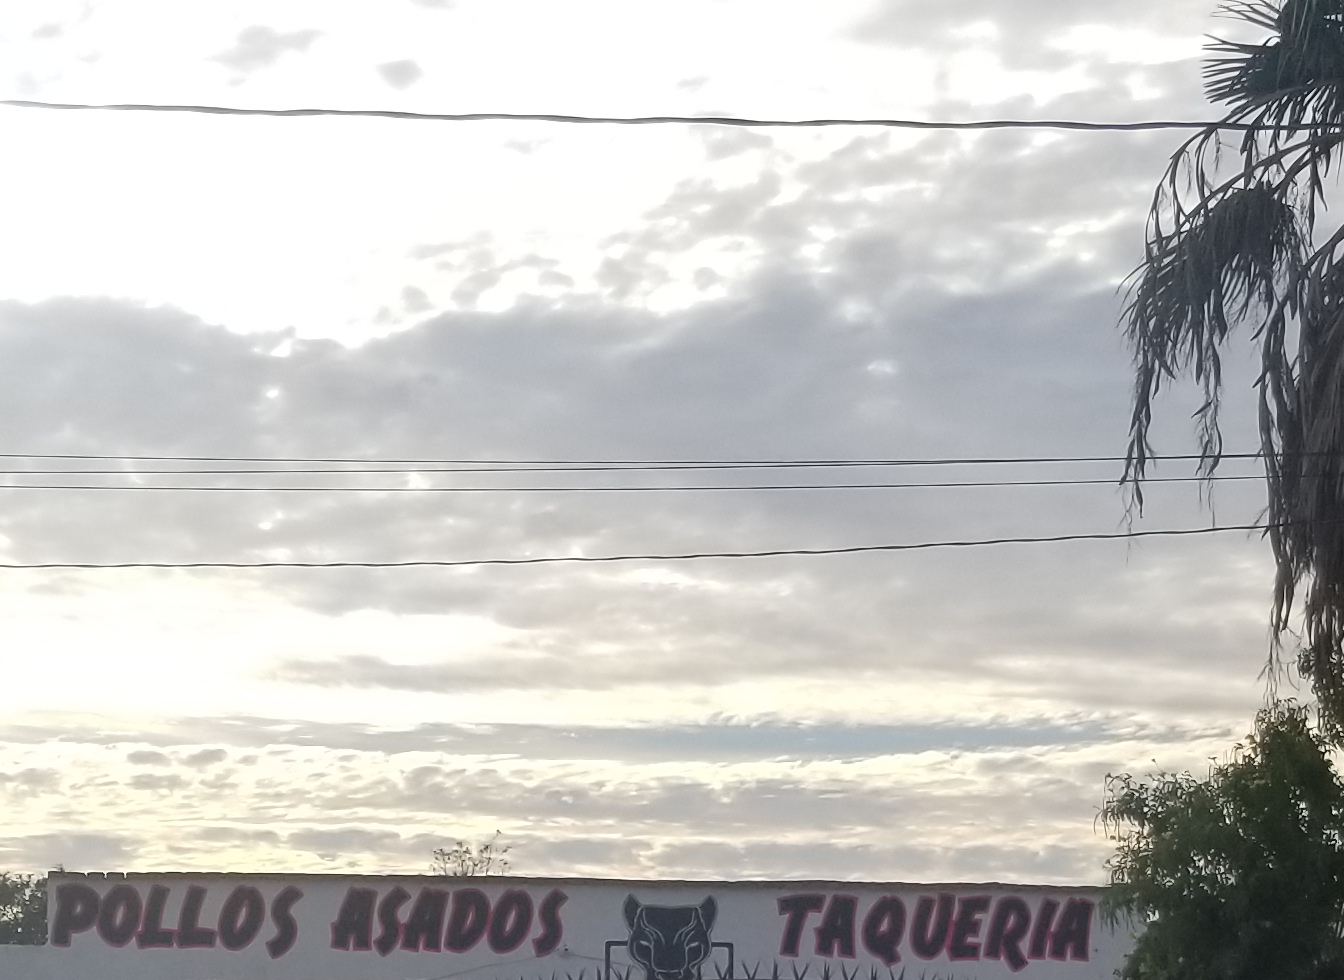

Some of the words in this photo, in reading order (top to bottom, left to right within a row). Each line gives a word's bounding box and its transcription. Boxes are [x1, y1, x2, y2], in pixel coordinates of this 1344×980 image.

[50, 882, 304, 960] POLLOS
[330, 885, 569, 958] ASADOS
[777, 892, 1094, 972] TAQUERIA
